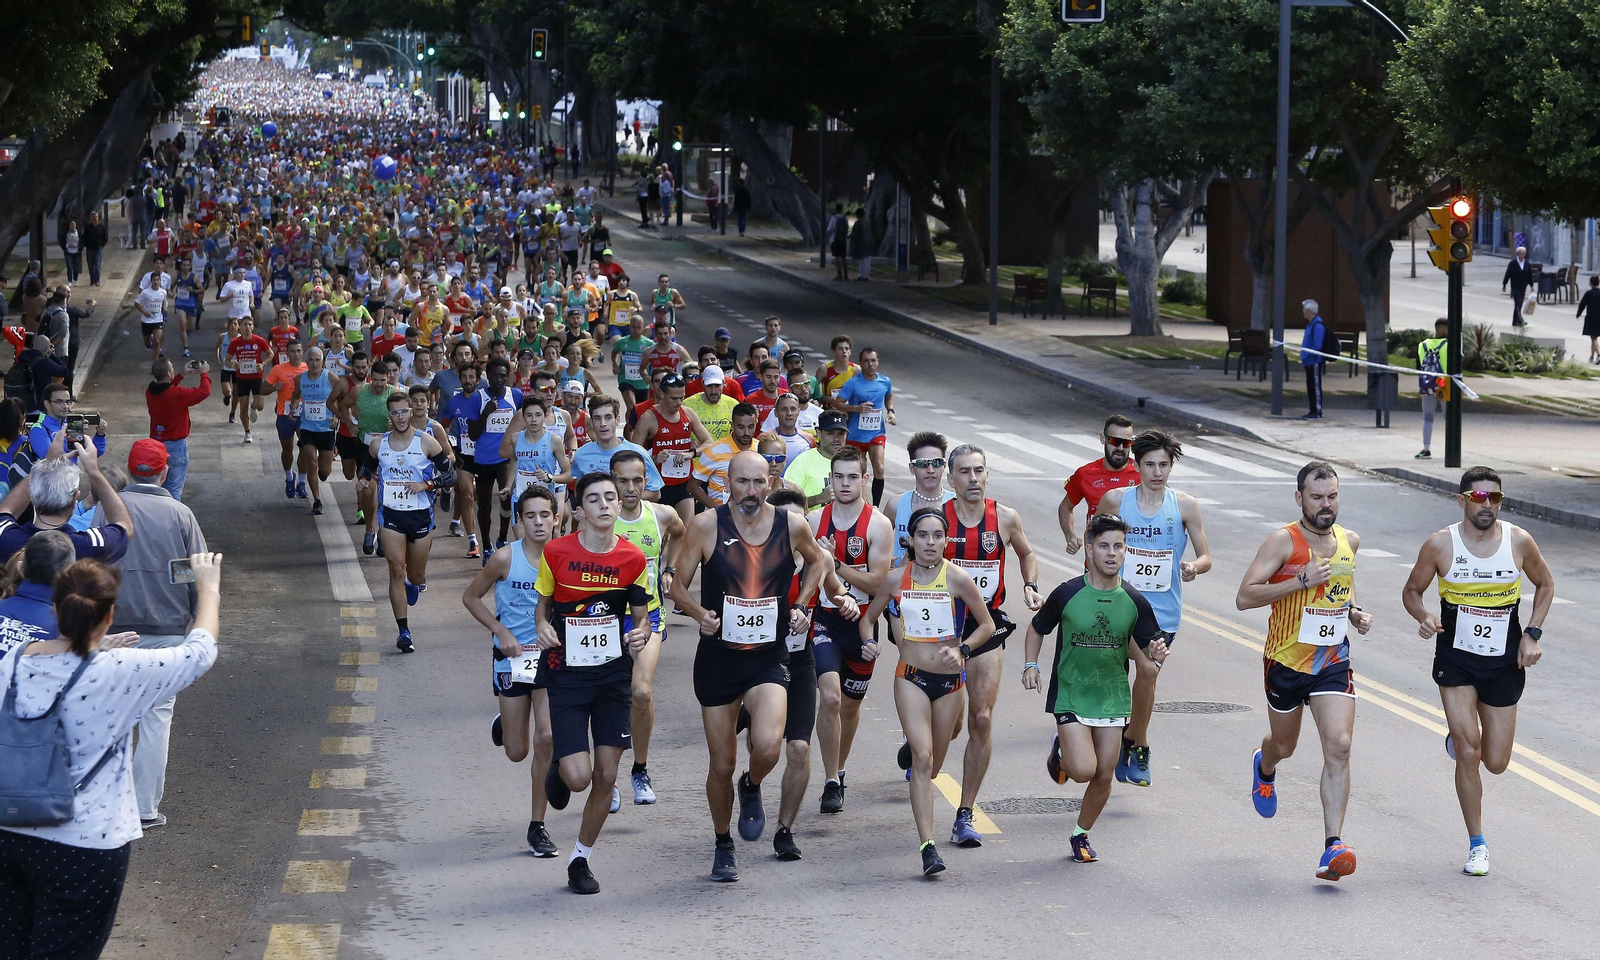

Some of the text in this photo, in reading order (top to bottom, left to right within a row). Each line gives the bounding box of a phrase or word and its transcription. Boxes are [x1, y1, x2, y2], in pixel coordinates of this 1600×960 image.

[491, 417, 510, 425] 6432
[391, 491, 409, 500] 141
[1127, 547, 1135, 555] 41
[568, 561, 620, 576] Málaga
[952, 559, 961, 567] 41
[1135, 563, 1161, 577] 267
[581, 572, 619, 585] Bahía
[973, 576, 988, 589] 16
[725, 596, 735, 605] 41
[921, 608, 930, 621] 3
[1460, 606, 1469, 614] 41
[567, 618, 577, 626] 41
[736, 614, 765, 628] 348
[1319, 624, 1335, 638] 84
[1473, 624, 1492, 639] 92
[580, 633, 608, 648] 418
